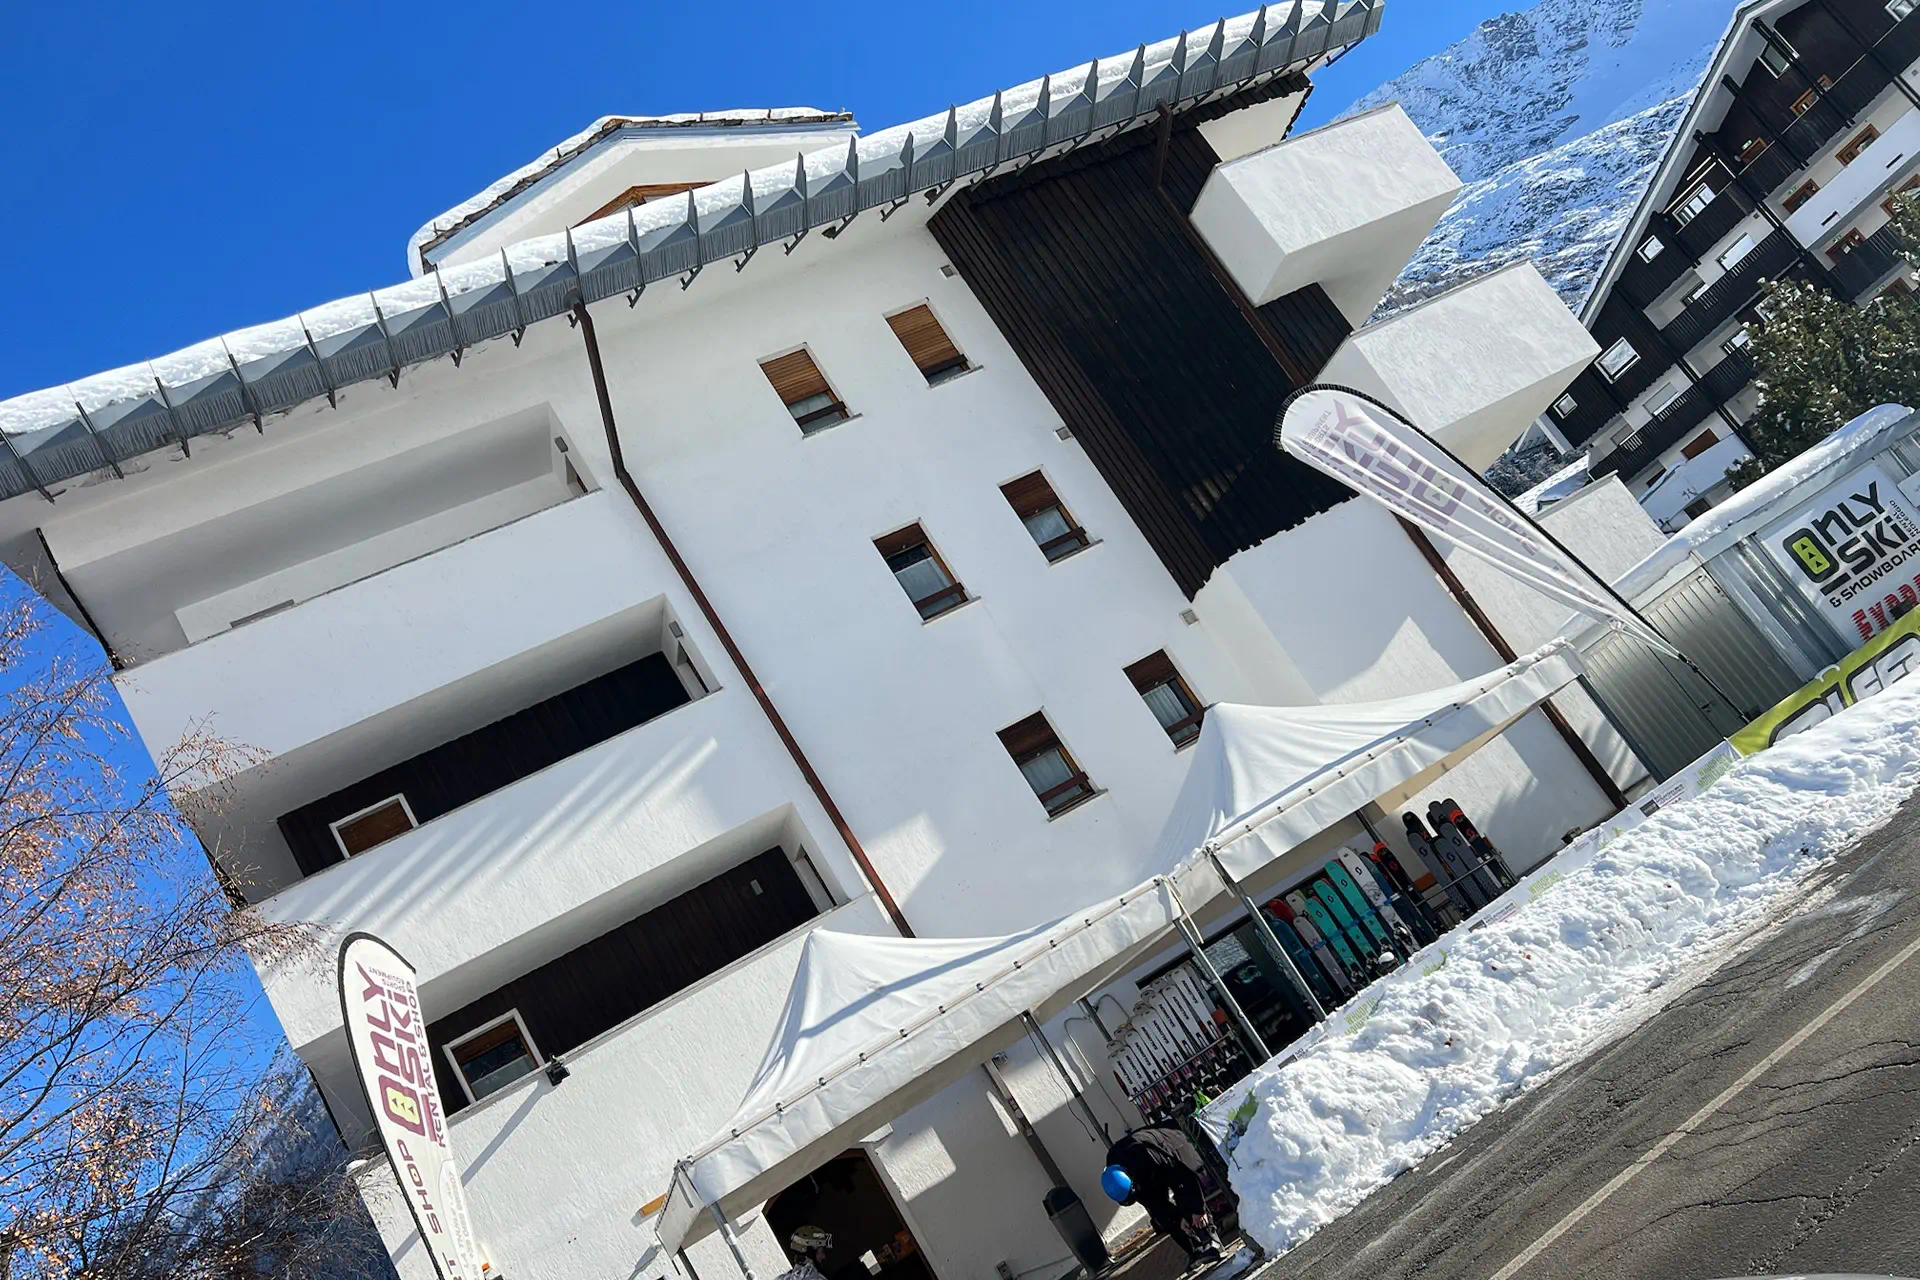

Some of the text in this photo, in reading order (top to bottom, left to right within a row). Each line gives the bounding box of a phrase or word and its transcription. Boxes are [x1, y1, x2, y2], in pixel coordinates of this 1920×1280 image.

[406, 981, 425, 1041] SHOP
[418, 1043, 428, 1058] &
[397, 1139, 443, 1234] SHOP
